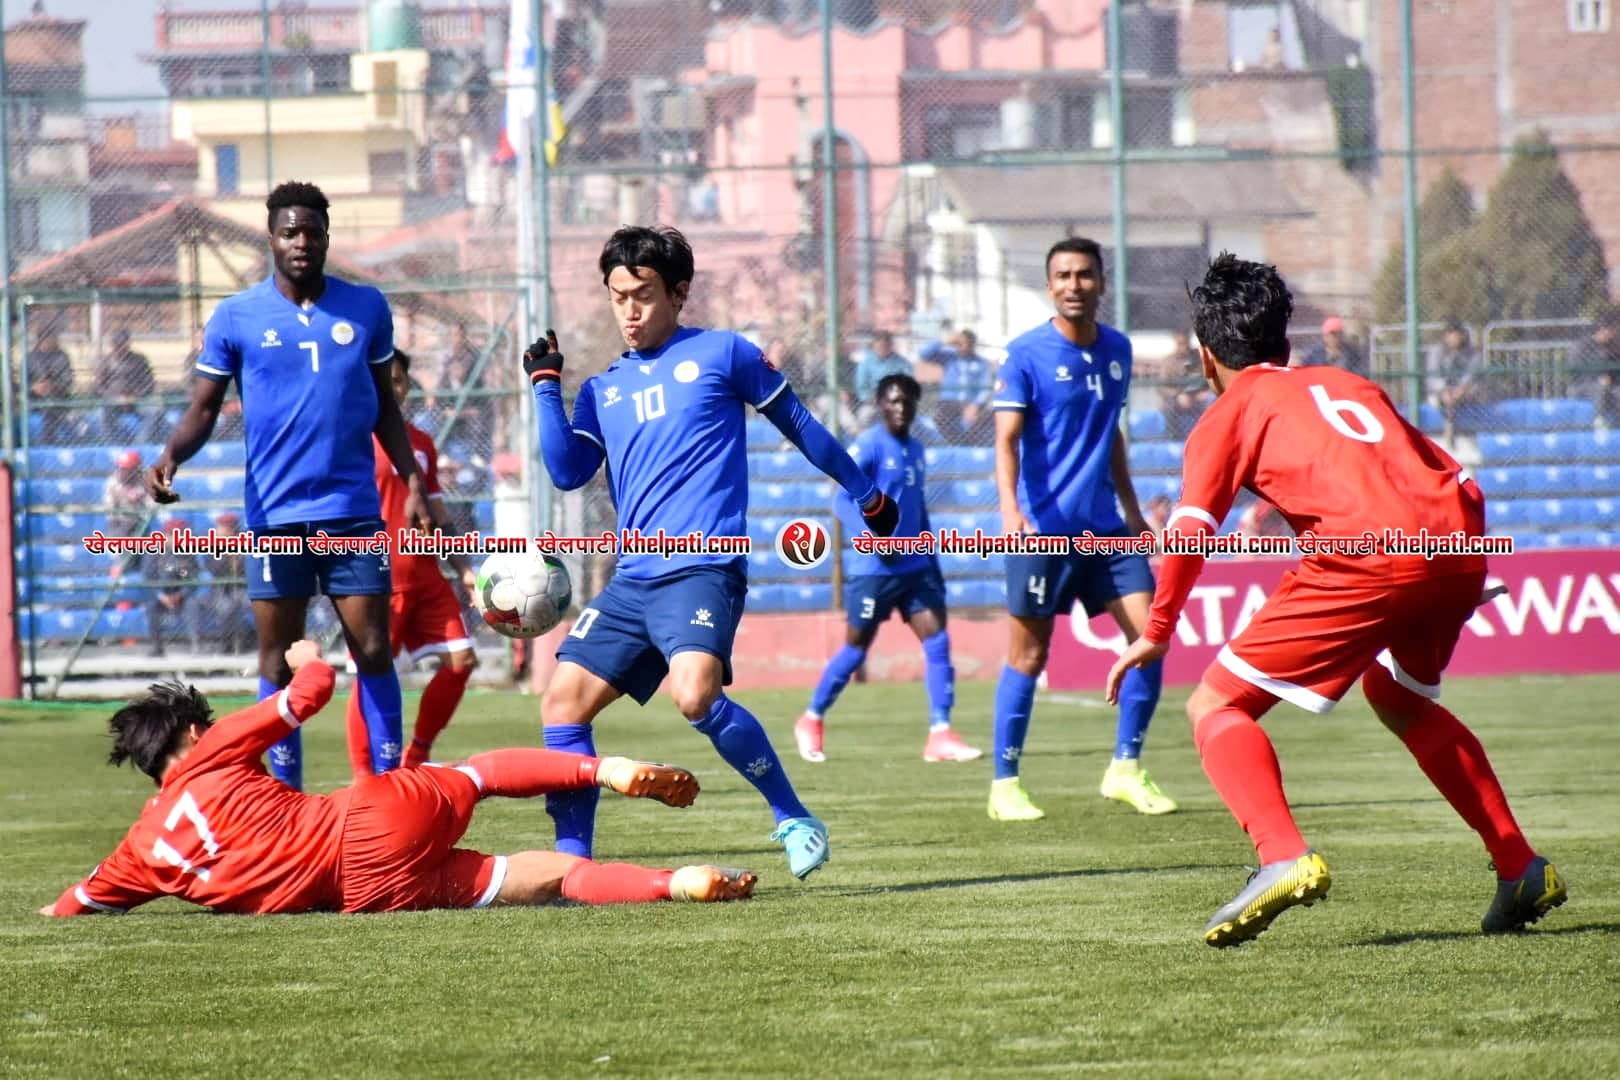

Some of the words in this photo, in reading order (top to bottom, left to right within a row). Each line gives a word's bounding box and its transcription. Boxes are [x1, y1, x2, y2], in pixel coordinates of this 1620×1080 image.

[299, 341, 319, 372] 7
[1086, 373, 1104, 400] 4
[632, 383, 666, 424] 10
[1308, 384, 1384, 443] 6
[904, 467, 916, 486] 3
[1028, 575, 1046, 605] 4
[860, 597, 876, 619] 3
[152, 790, 220, 883] 17
